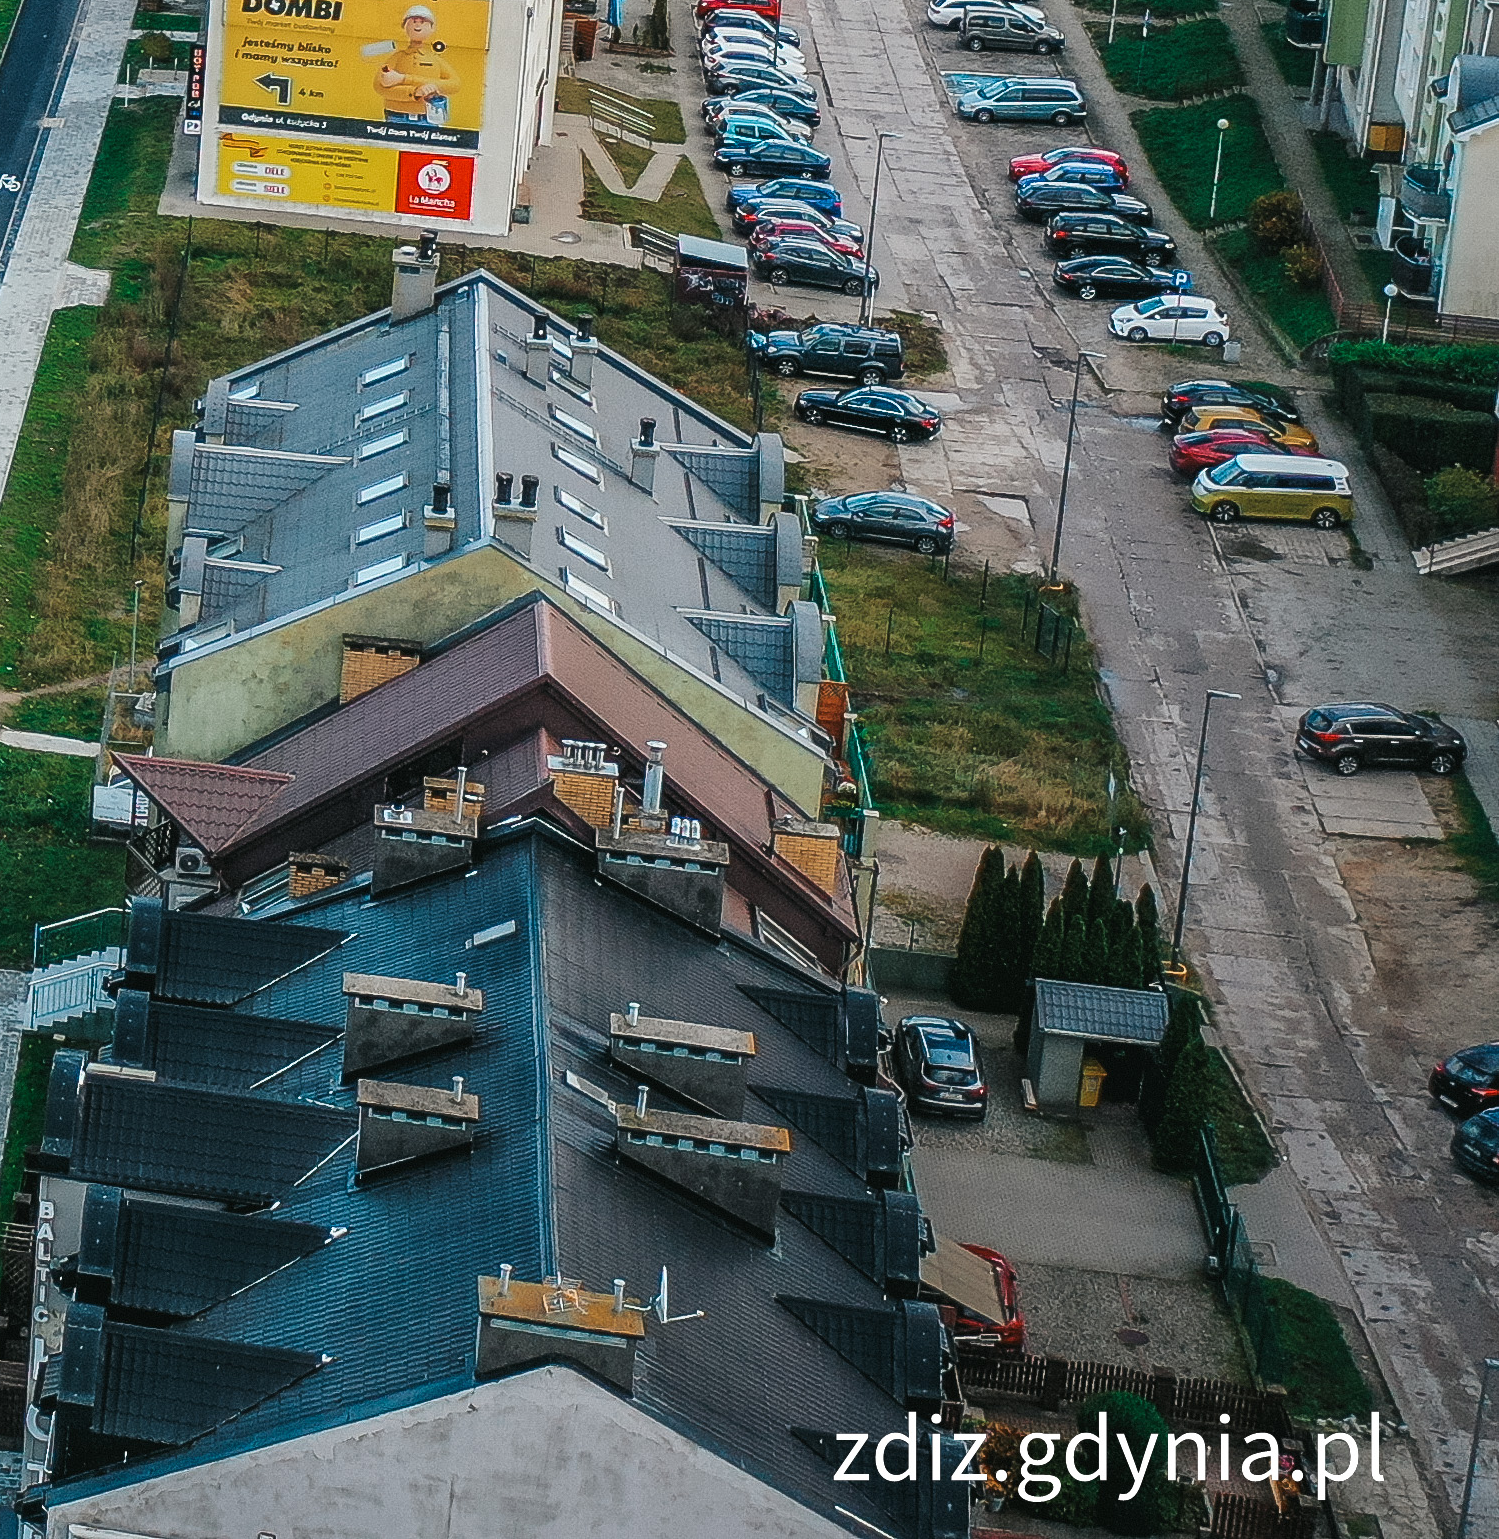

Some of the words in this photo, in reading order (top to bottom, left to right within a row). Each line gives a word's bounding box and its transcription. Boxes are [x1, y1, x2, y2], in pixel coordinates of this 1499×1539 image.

[241, 52, 278, 65] mamy
[298, 87, 307, 97] 4
[308, 89, 324, 99] km
[1175, 272, 1188, 286] P
